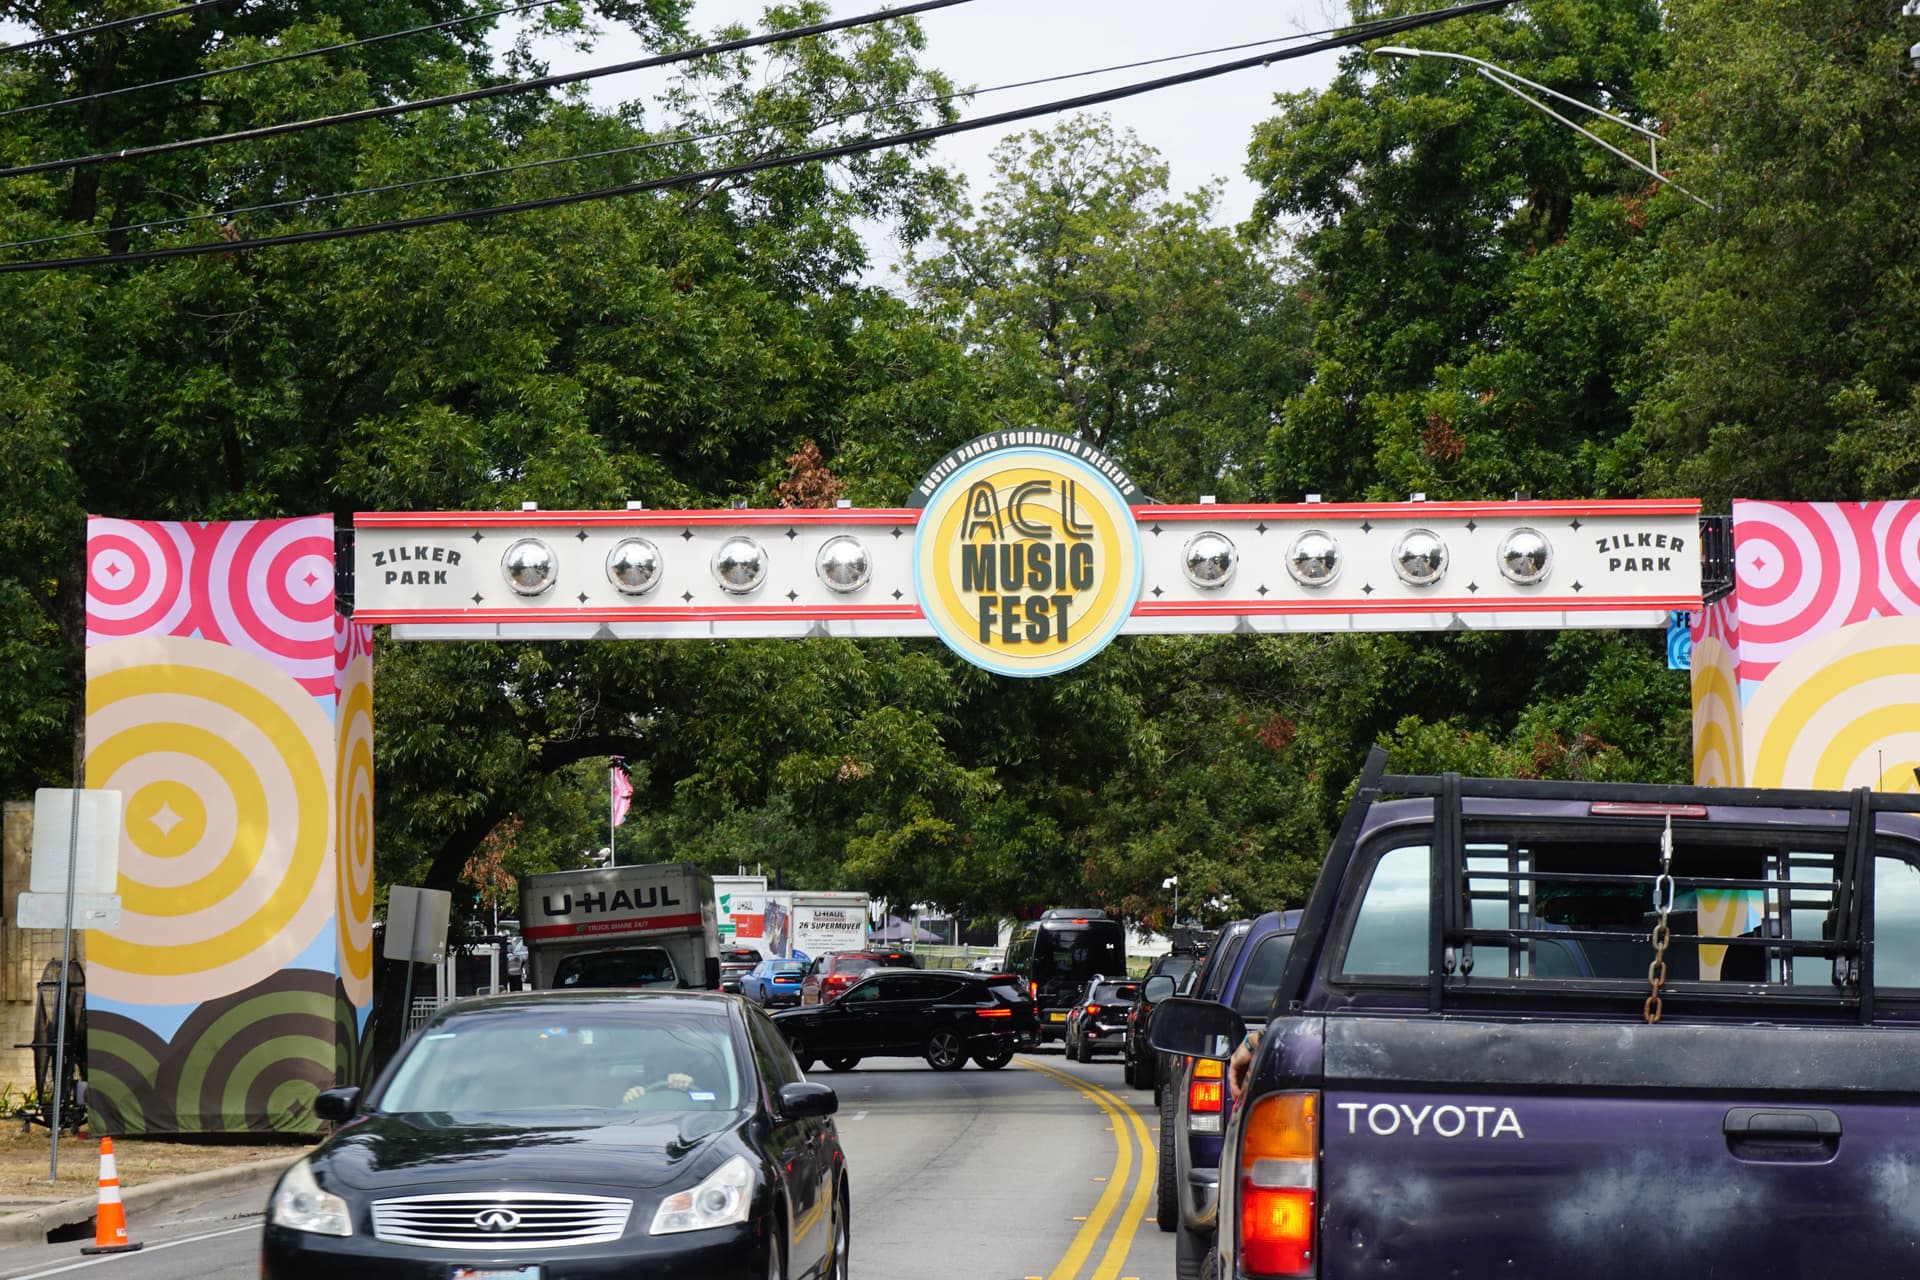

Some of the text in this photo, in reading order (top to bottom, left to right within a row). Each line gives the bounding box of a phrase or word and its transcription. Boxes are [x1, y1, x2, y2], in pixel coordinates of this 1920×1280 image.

[920, 431, 1135, 496] AUSTIN PARKS FOUNDATION PRESENTS
[961, 479, 1094, 540] ACL
[372, 546, 462, 567] ZILKER
[1595, 533, 1685, 554] ZILKER
[385, 570, 447, 585] PARK
[962, 542, 1094, 592] MUSIC
[1609, 557, 1671, 572] PARK
[979, 595, 1073, 644] FEST
[810, 922, 861, 930] SUPERMOVER
[1336, 1103, 1525, 1139] TOYOTA
